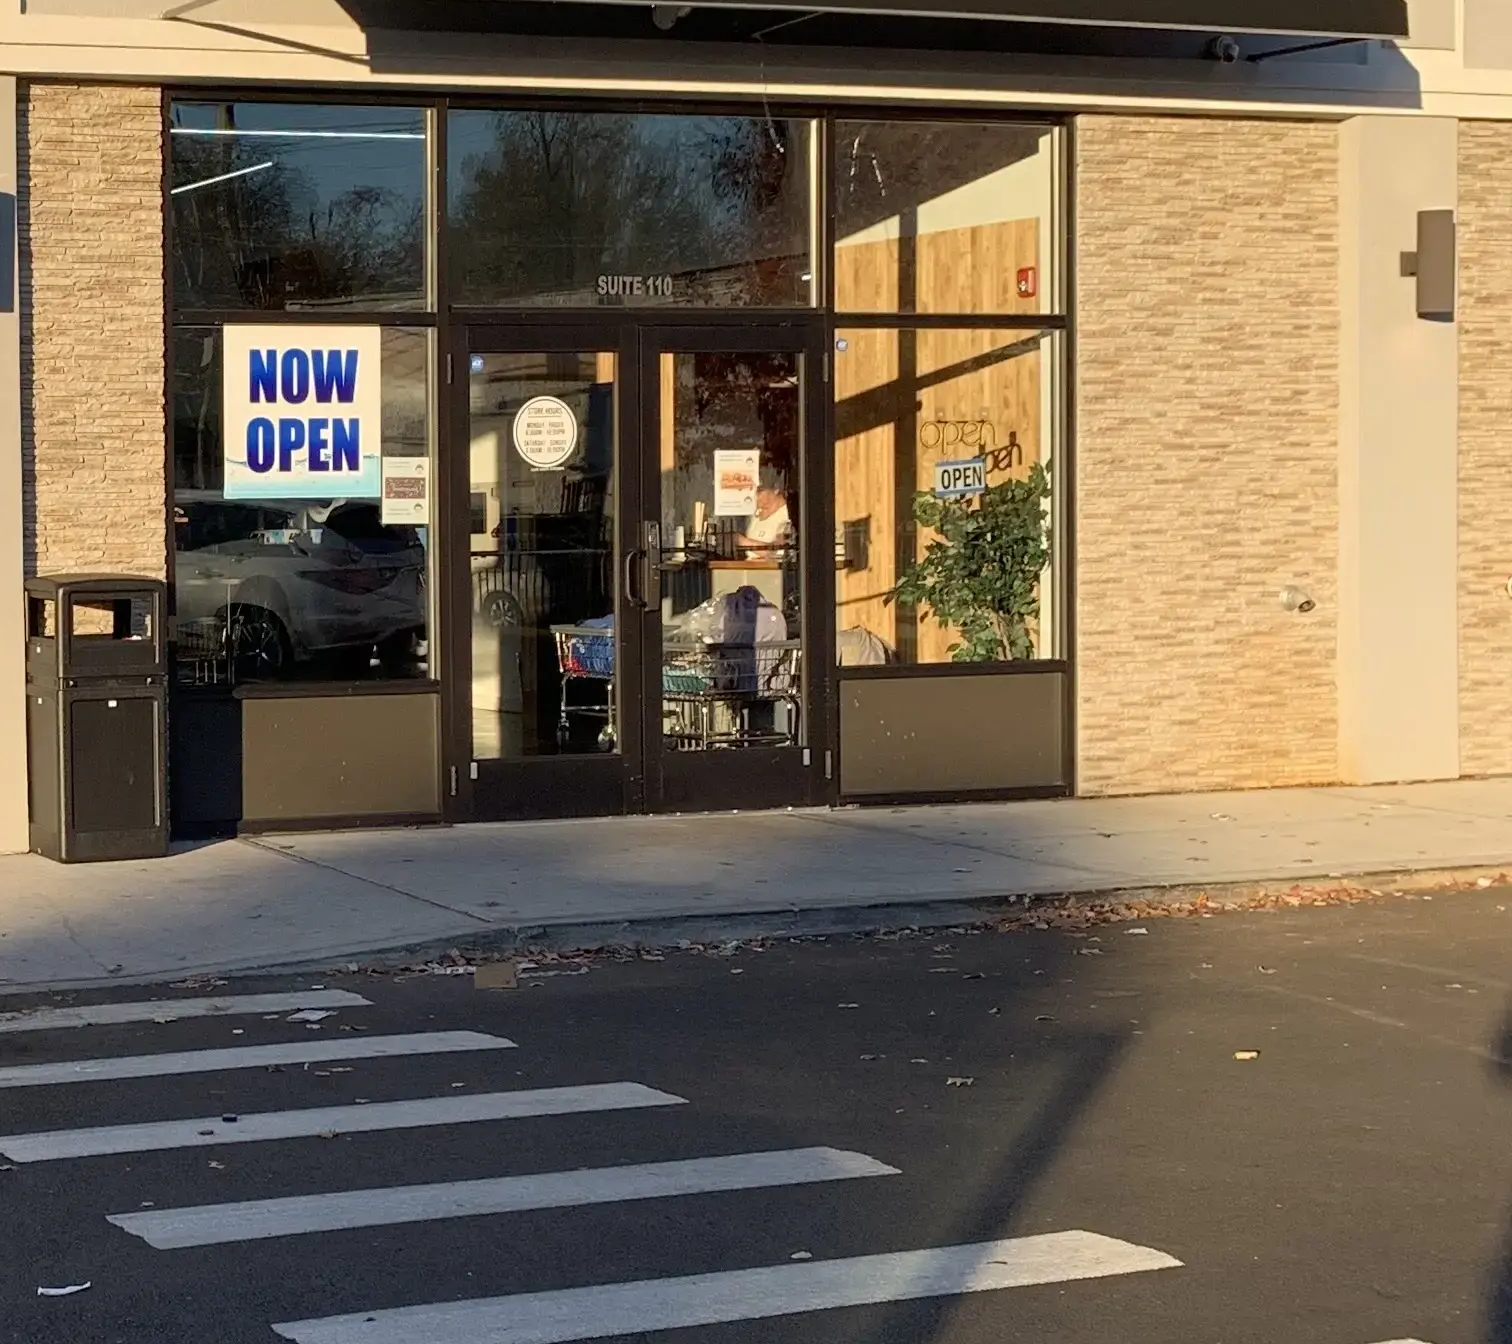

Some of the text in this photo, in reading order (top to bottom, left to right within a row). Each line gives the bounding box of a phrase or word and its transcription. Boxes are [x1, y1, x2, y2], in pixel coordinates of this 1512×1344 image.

[598, 276, 673, 296] SUITE 110
[249, 348, 358, 404] NOW
[246, 417, 360, 473] OPEN
[941, 466, 982, 490] OPEN
